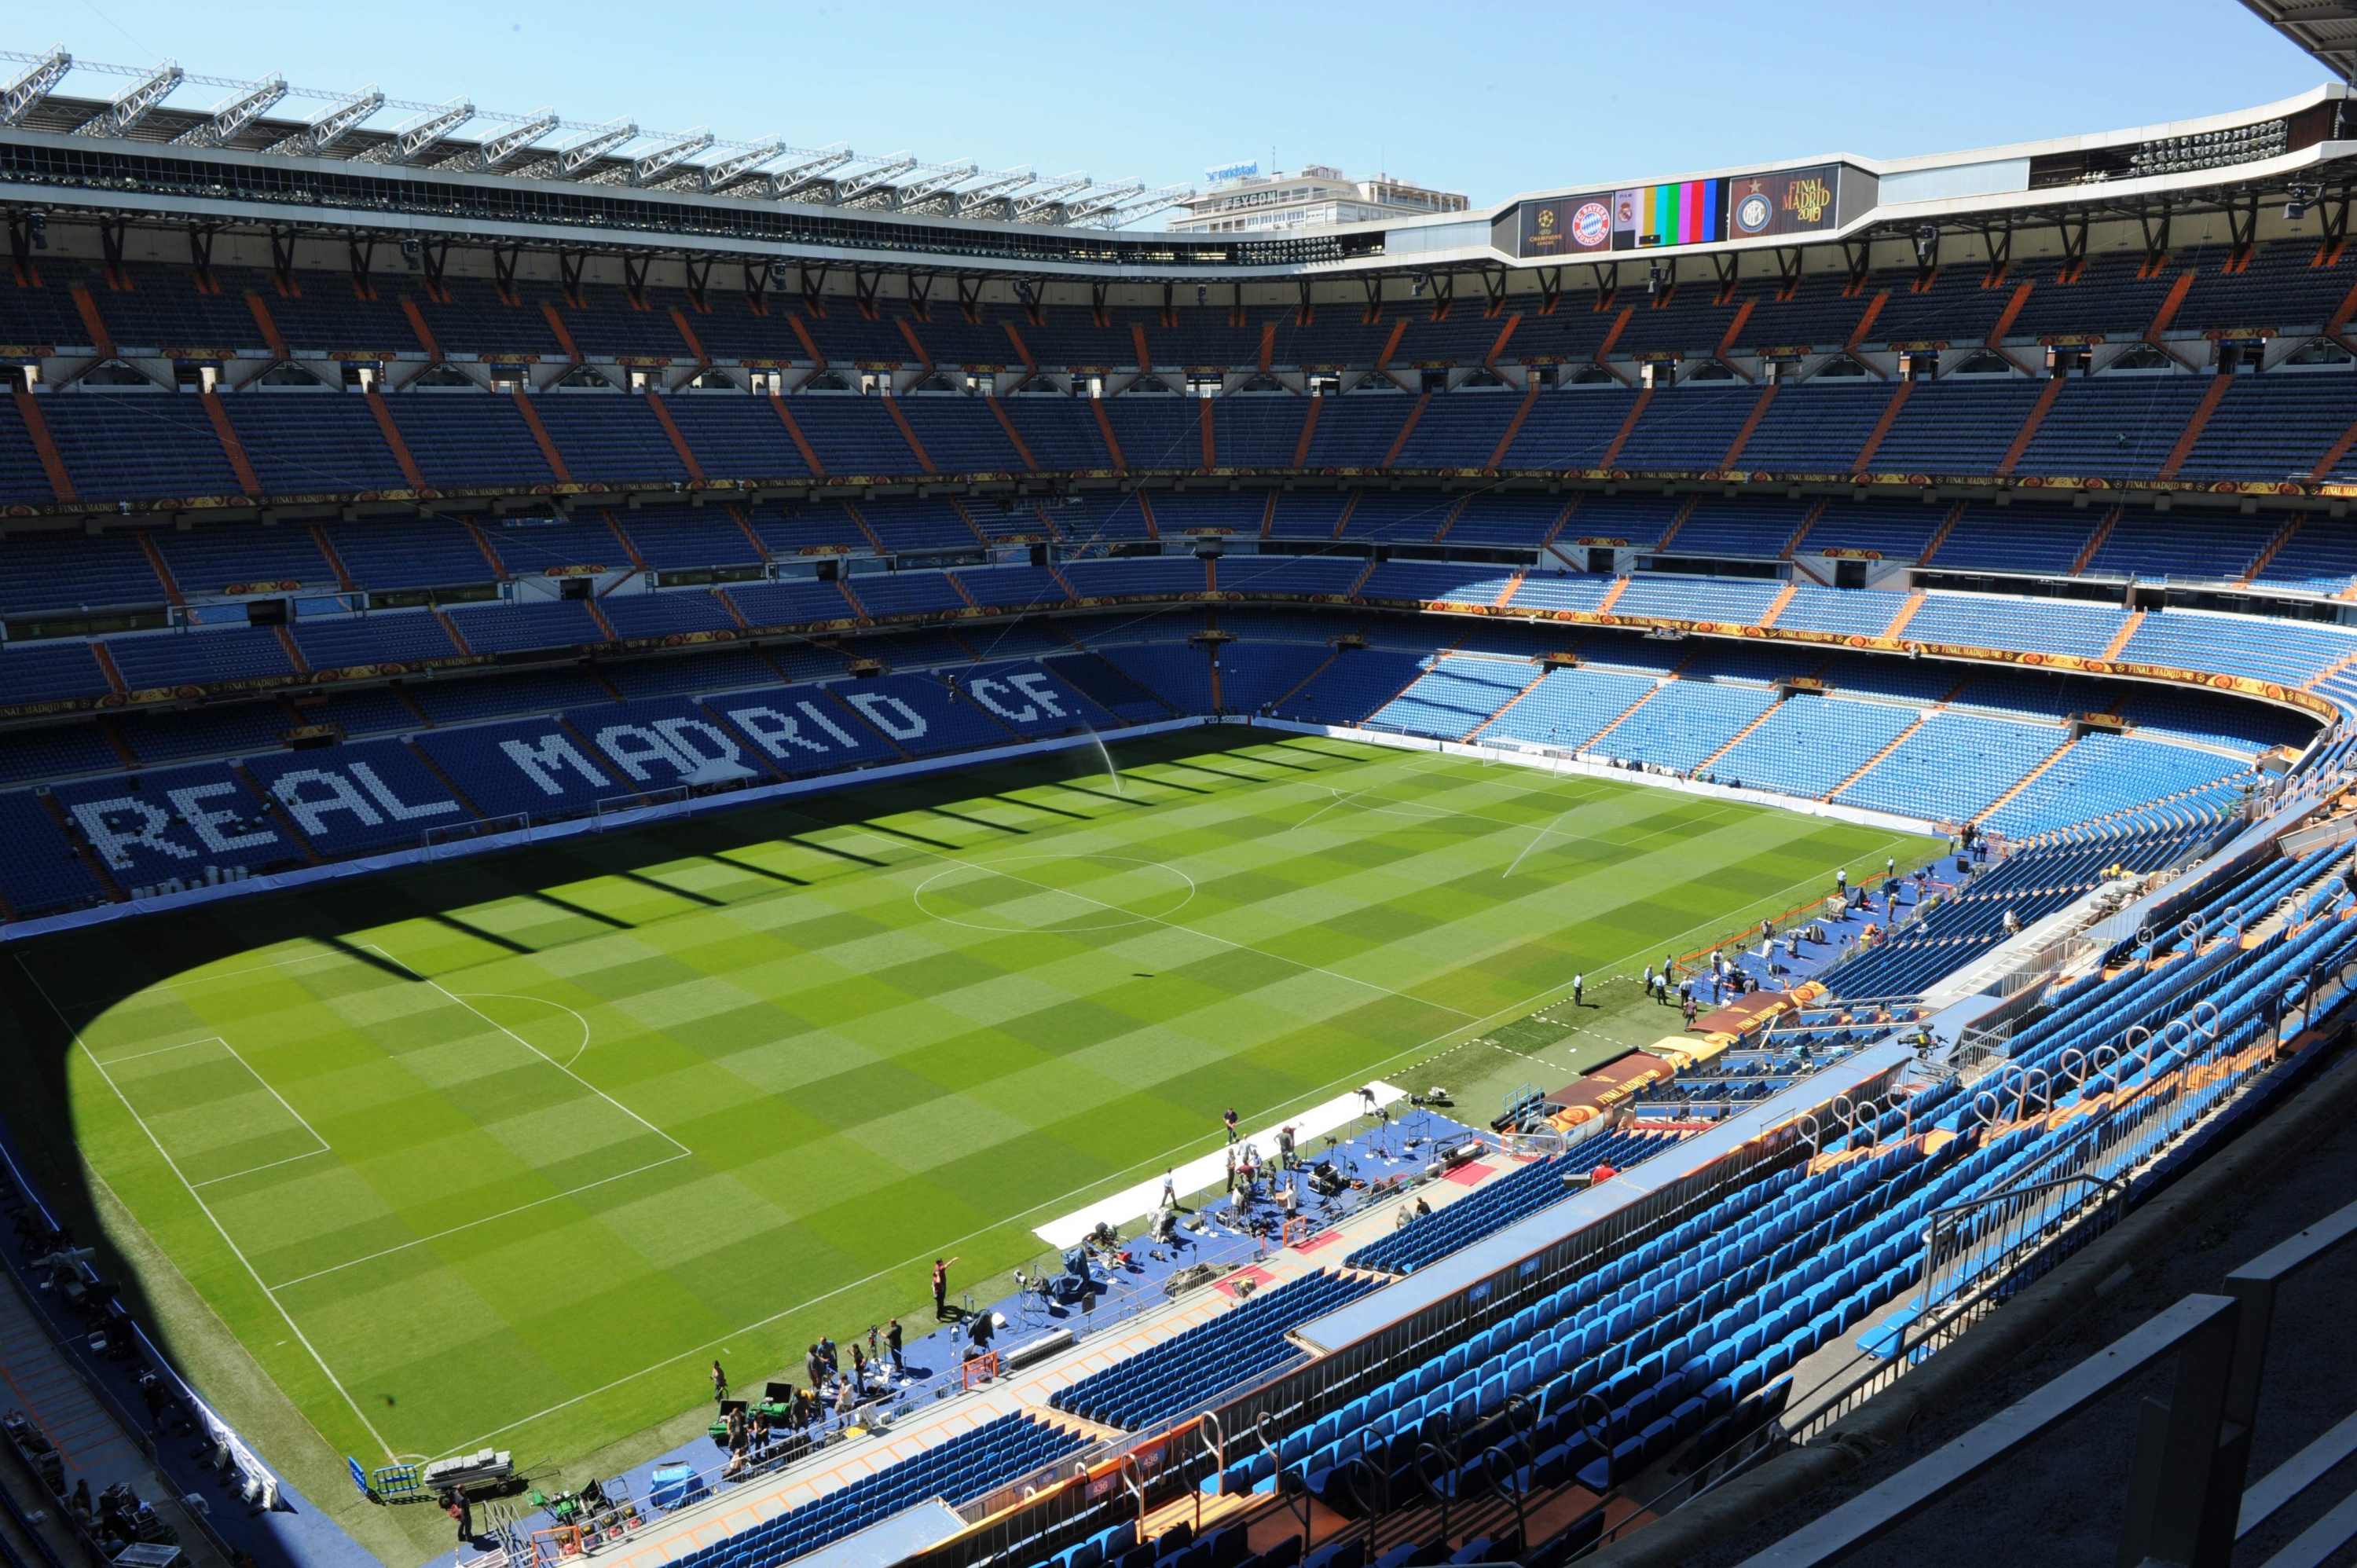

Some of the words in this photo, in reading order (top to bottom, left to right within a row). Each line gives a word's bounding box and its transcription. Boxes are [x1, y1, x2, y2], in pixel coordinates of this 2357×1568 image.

[1219, 160, 1256, 181] randstad
[1789, 178, 1824, 194] FINAL
[1782, 190, 1830, 211] MADRID
[1582, 204, 1607, 220] BAYERN
[1798, 206, 1821, 222] 2010
[1967, 477, 1992, 485] MADRID
[2150, 482, 2179, 491] MADRID
[2322, 485, 2342, 495] FINAL
[299, 495, 324, 504] MADRID
[86, 503, 118, 512] MADRID
[1942, 646, 1962, 654] FINAL
[1963, 647, 1989, 658] MADRID
[2128, 665, 2151, 675] FINAL
[2152, 668, 2181, 679] MADRID
[223, 682, 248, 691] FINAL
[248, 678, 280, 687] MADRID
[24, 703, 60, 714] MADRID
[71, 762, 460, 871] REAL
[500, 693, 927, 795] MADRID
[1736, 1018, 1760, 1031] FINAL
[1752, 1006, 1779, 1021] MADRID
[1595, 1089, 1624, 1105] FINAL
[1616, 1075, 1649, 1094] MADRID
[1144, 1453, 1158, 1465] 436
[1094, 1482, 1108, 1493] 436
